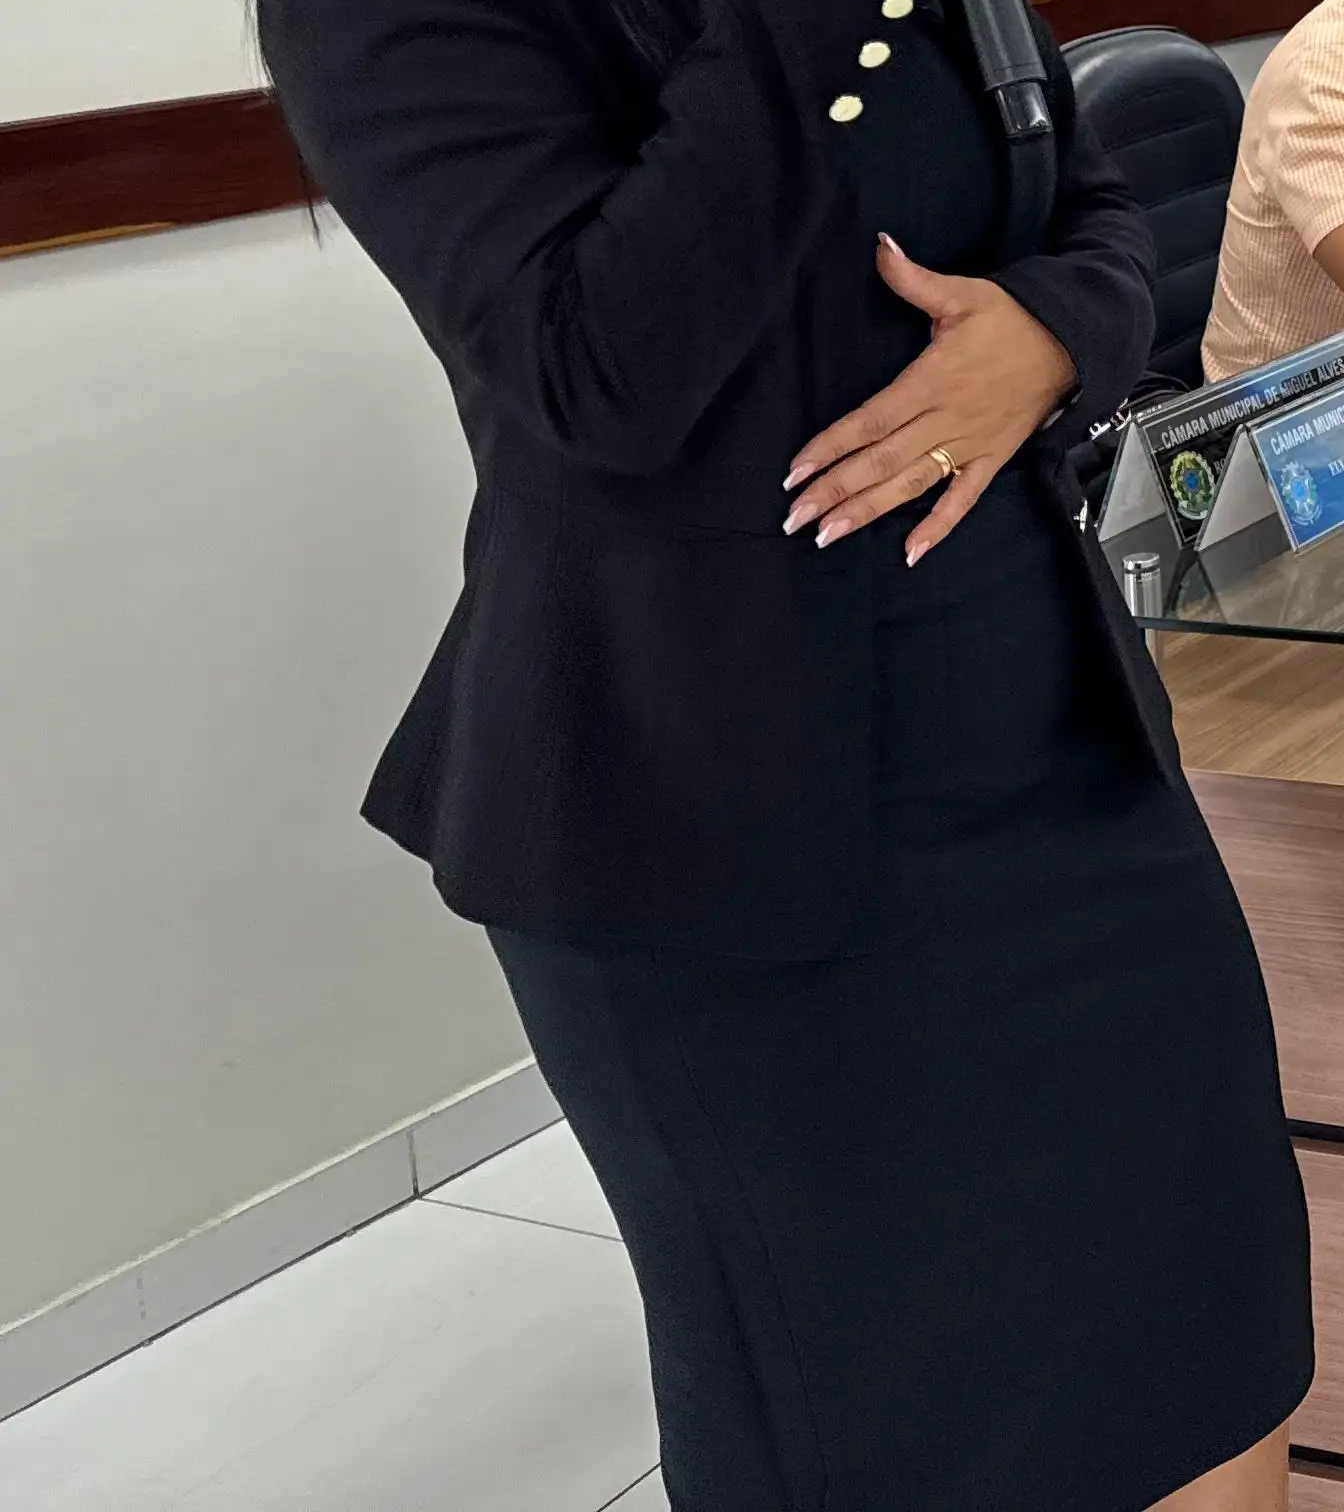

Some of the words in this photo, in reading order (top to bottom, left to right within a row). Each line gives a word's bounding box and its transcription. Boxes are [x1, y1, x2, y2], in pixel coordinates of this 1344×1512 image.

[1161, 416, 1211, 450] CÂMARA
[1208, 392, 1266, 430] MUNICIPAL
[1264, 387, 1282, 407] DE
[1281, 372, 1319, 399] MIGUEL
[1270, 423, 1315, 456] CÂMARA
